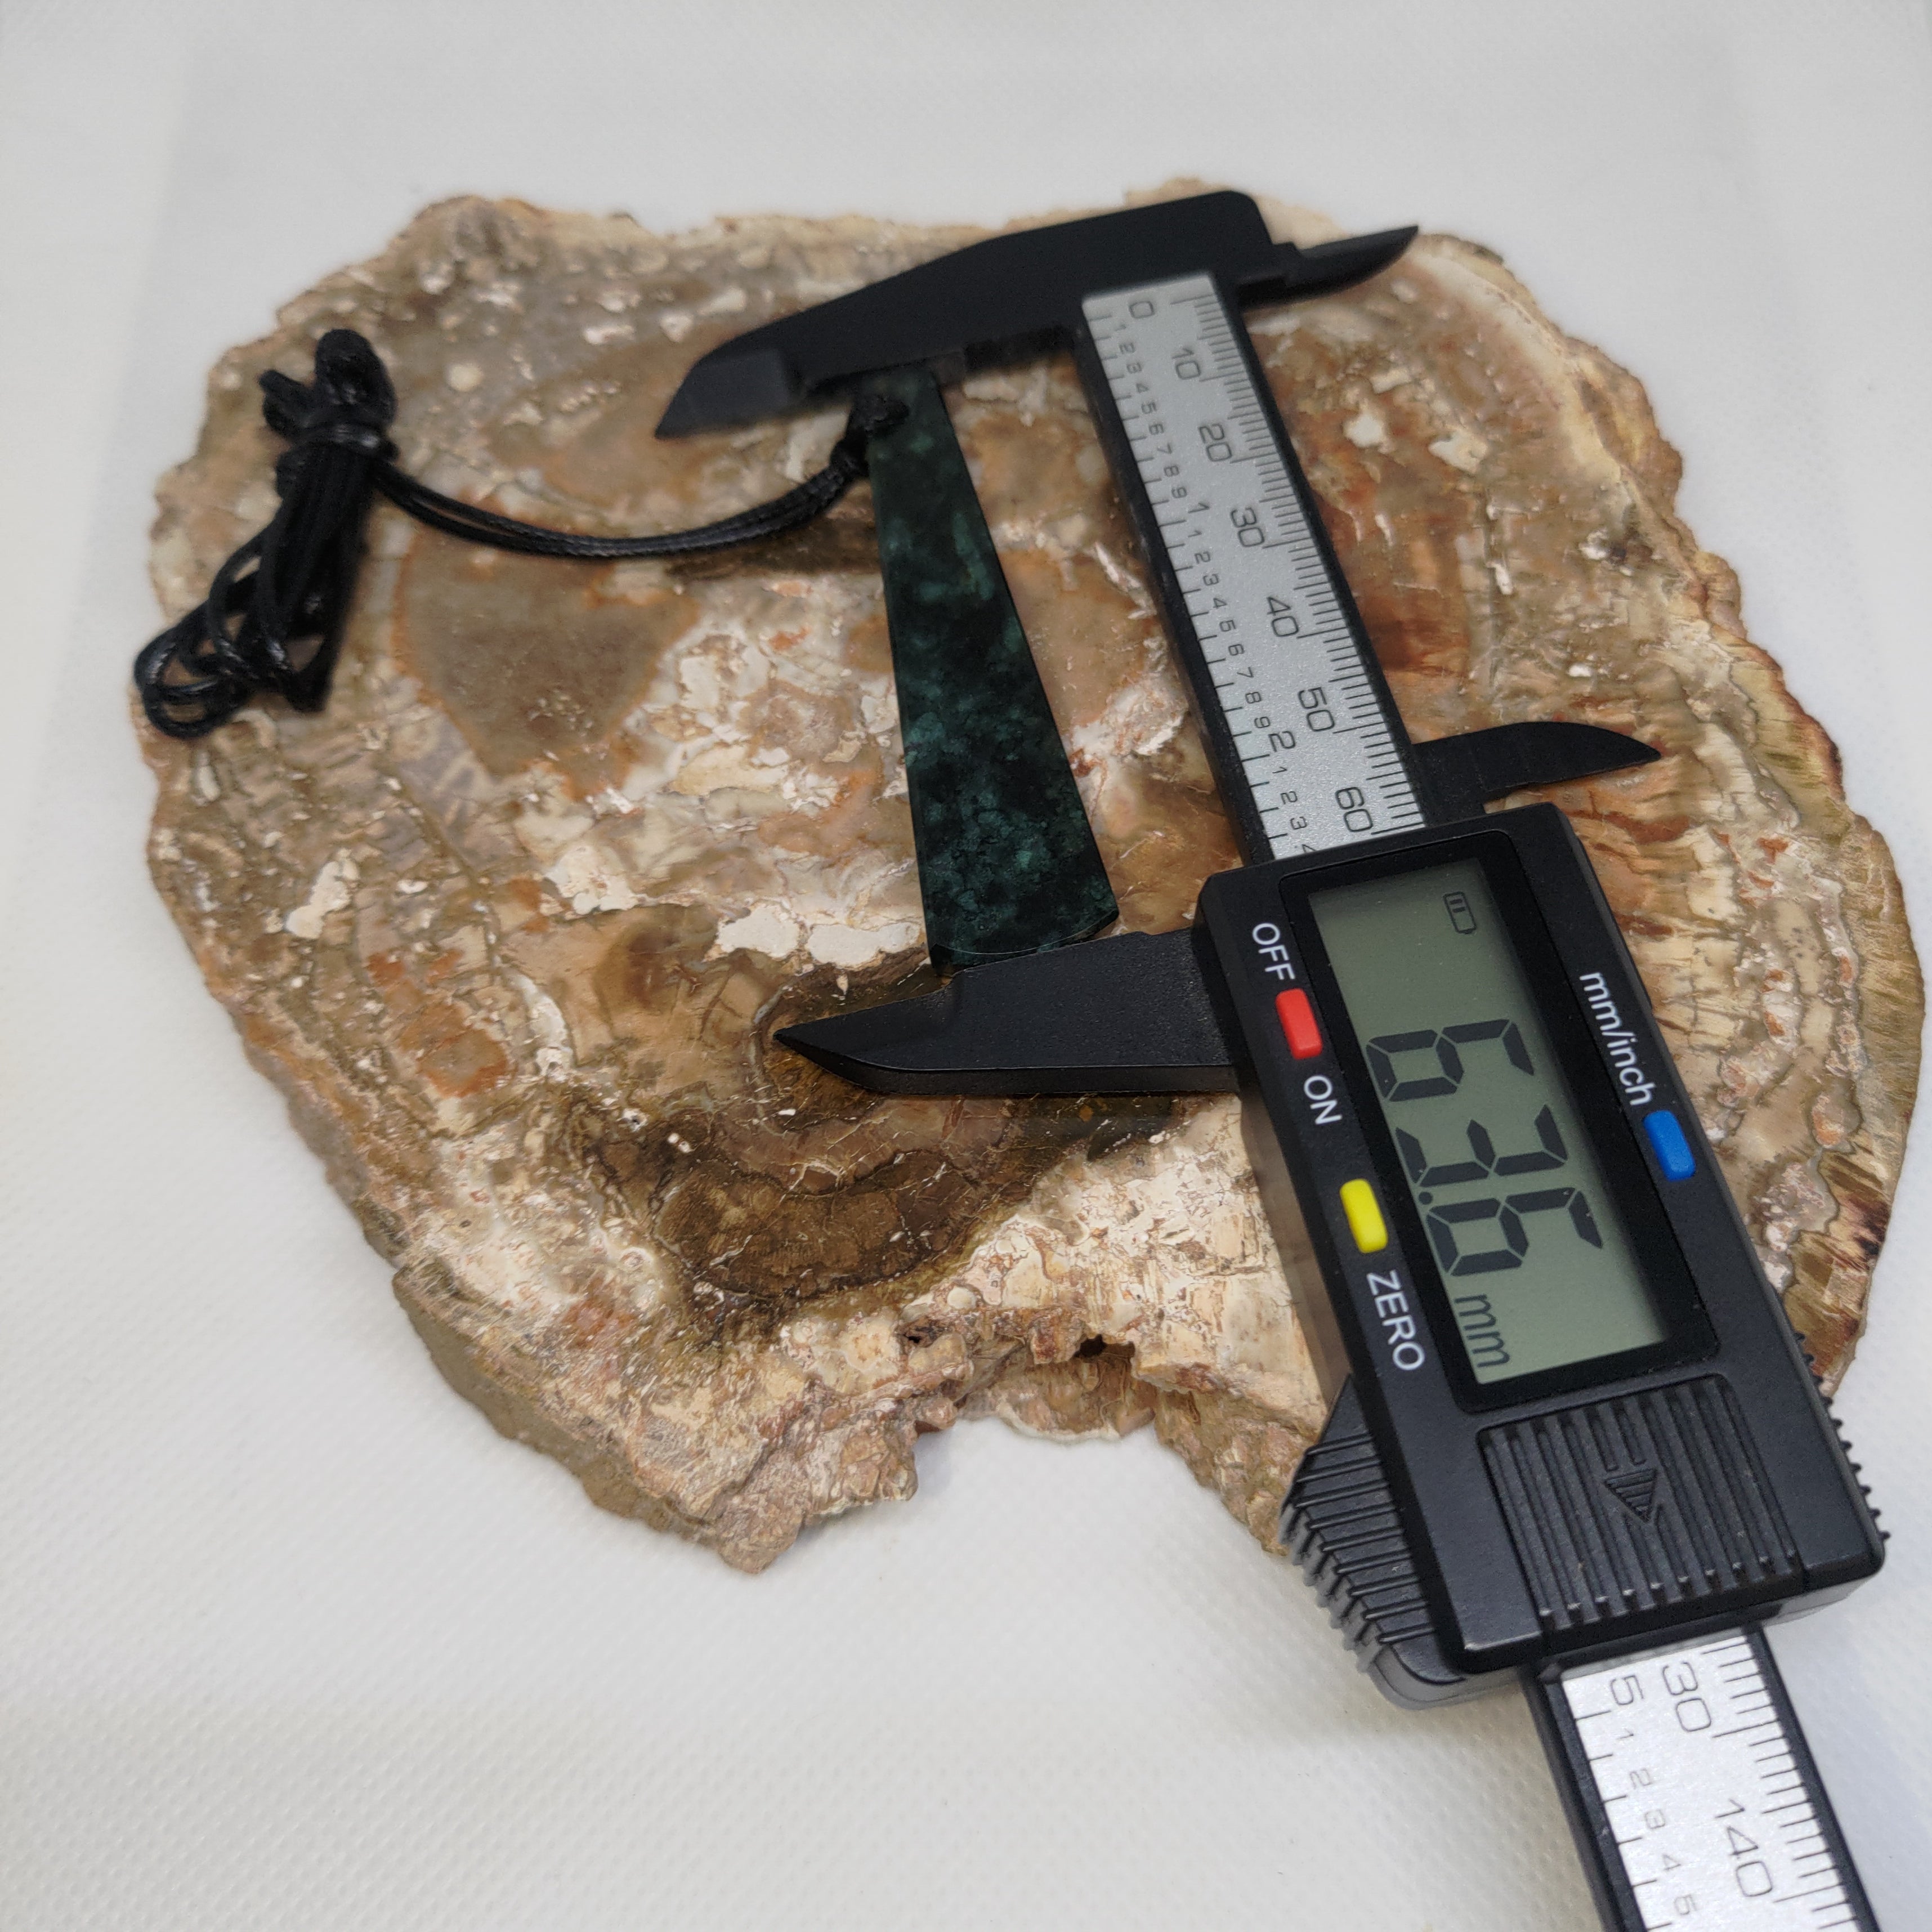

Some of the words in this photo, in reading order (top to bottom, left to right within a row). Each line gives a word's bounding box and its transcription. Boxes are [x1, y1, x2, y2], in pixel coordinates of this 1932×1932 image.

[1120, 342, 1135, 355] 2
[1127, 362, 1142, 374] 3
[1136, 383, 1149, 393] 4
[1142, 401, 1157, 414] 5
[1148, 423, 1164, 435] 6
[1157, 442, 1172, 455] 7
[1164, 464, 1179, 477] 8
[1171, 487, 1187, 499] 9
[1188, 502, 1210, 514] 1
[1188, 529, 1202, 538] 1
[1195, 551, 1211, 564] 2
[1129, 301, 1155, 319] 0
[1171, 348, 1201, 380] 10
[1197, 423, 1233, 462] 20
[1230, 507, 1265, 548] 30
[1266, 596, 1299, 637] 40
[1297, 686, 1335, 732] 50
[1335, 786, 1374, 833] 60
[1202, 573, 1219, 586] 3
[1213, 597, 1227, 609] 4
[1219, 619, 1236, 632] 5
[1228, 643, 1245, 656] 6
[1237, 667, 1254, 678] 7
[1245, 691, 1262, 704] 8
[1254, 716, 1271, 728] 9
[1268, 731, 1296, 752] 2
[1280, 790, 1298, 804] 2
[1290, 816, 1308, 830] 3
[1251, 922, 1296, 982] OFF
[1578, 972, 1656, 1106] mm/inch
[1303, 1074, 1343, 1125] ON
[1365, 1018, 1604, 1277] 63.6
[1366, 1269, 1425, 1372] ZERO
[1455, 1293, 1511, 1368] mm
[1662, 1662, 1712, 1732] 30
[1714, 1799, 1773, 1897] 140
[1610, 1674, 1644, 1706] 5
[1629, 1768, 1654, 1789] 2
[1644, 1809, 1666, 1830] 3
[1661, 1853, 1682, 1872] 4
[1674, 1894, 1697, 1916] 5
